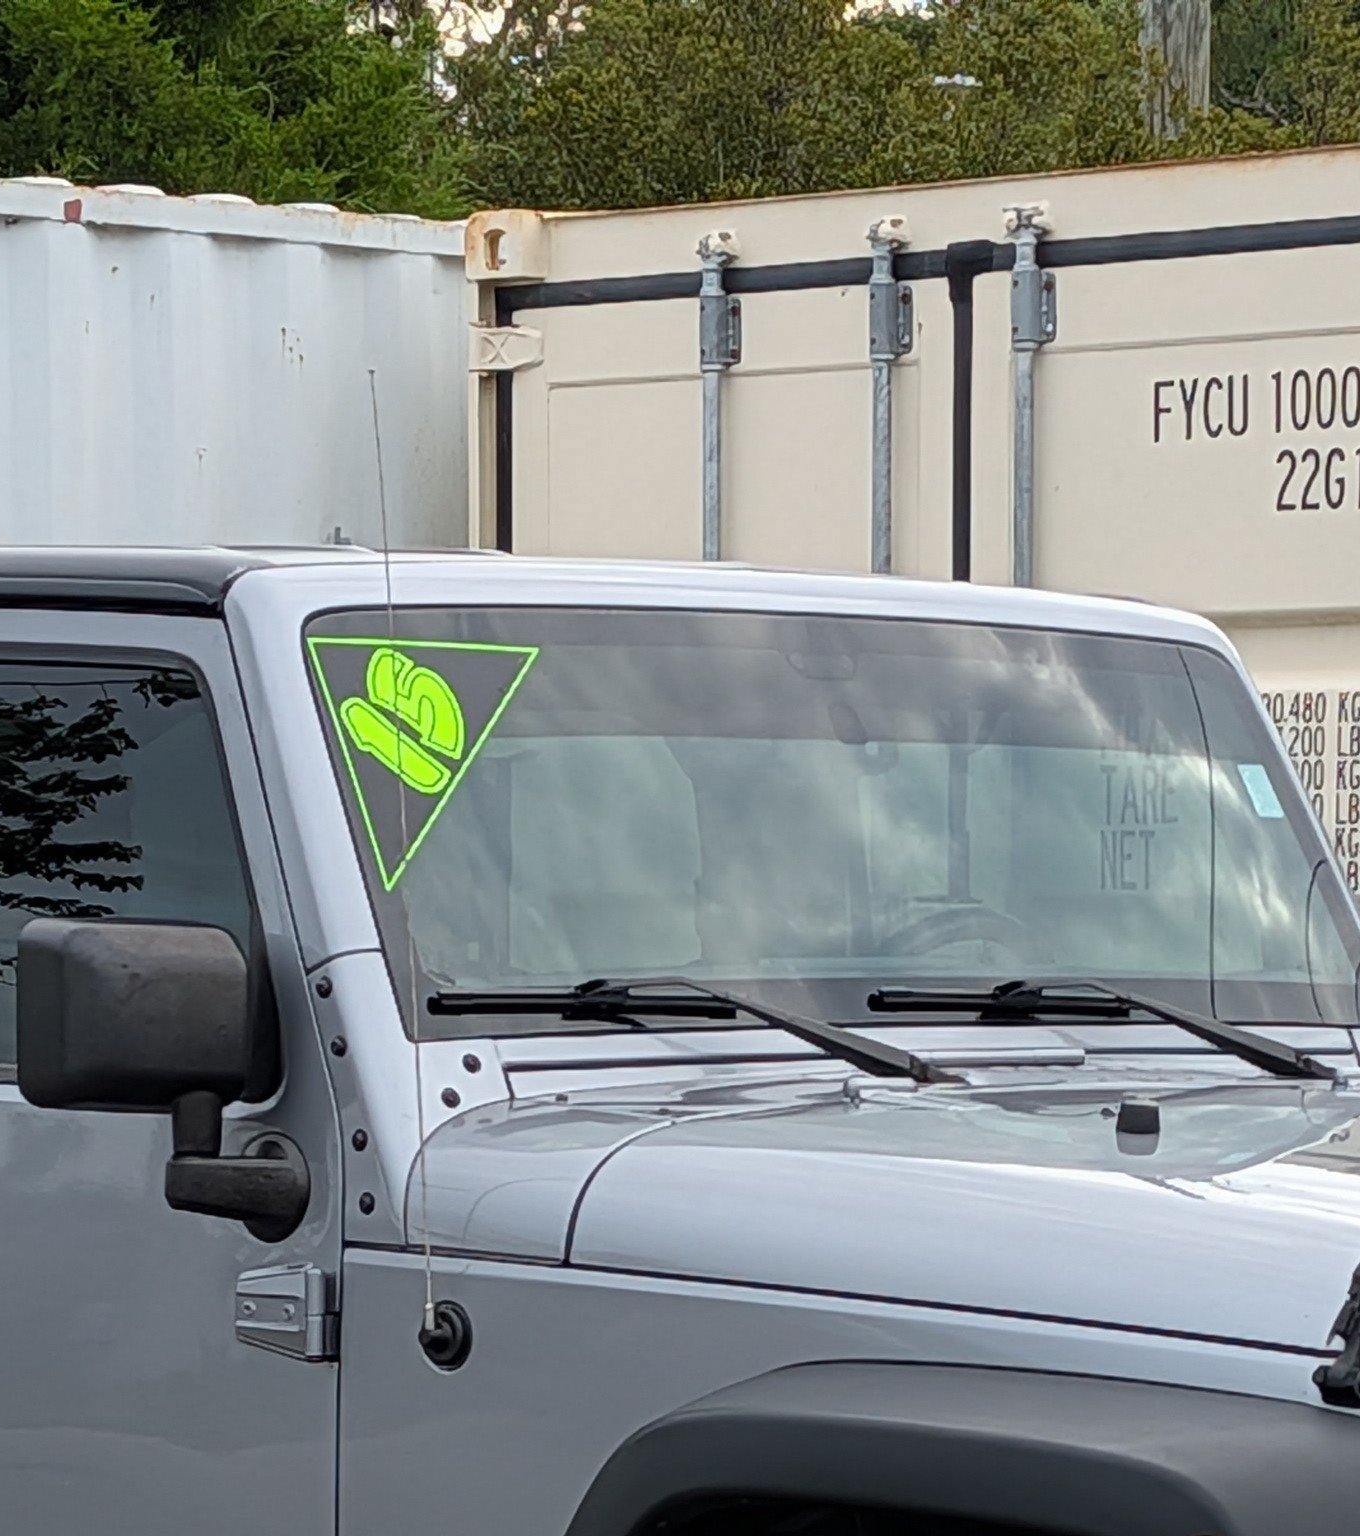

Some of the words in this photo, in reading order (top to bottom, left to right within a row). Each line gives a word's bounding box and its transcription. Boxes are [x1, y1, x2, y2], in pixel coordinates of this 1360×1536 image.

[1153, 373, 1249, 444] FYCU
[1099, 763, 1179, 826] TARE
[1099, 829, 1156, 891] NET
